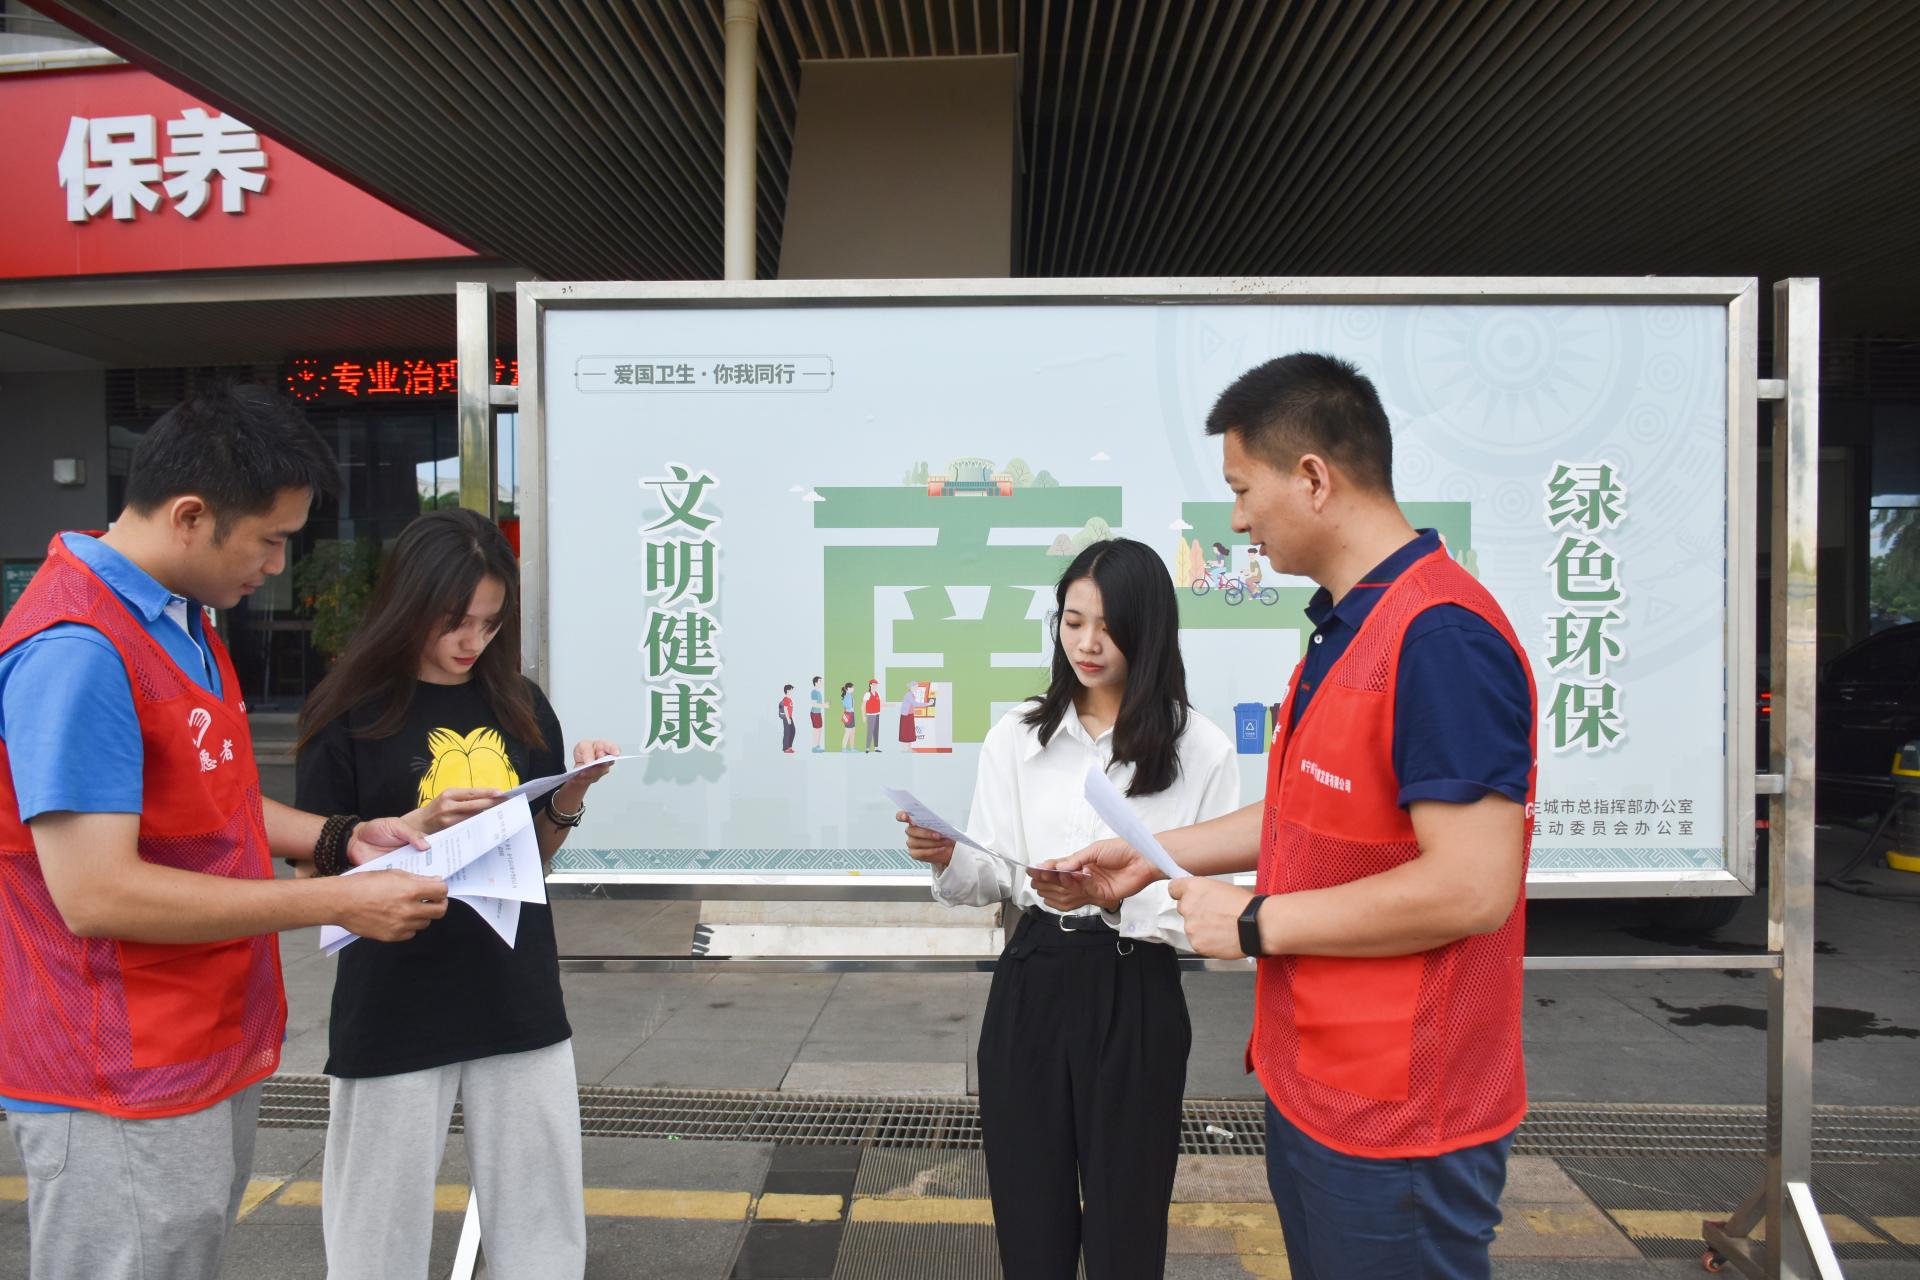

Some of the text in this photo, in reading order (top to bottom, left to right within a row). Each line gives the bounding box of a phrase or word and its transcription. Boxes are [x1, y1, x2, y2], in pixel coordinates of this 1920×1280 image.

[57, 108, 268, 222] 保养
[331, 358, 519, 396] 专业治理
[613, 363, 796, 385] 爱国卫生·你我同行
[642, 464, 719, 750] 文明健康
[1545, 463, 1623, 749] 绿色环保
